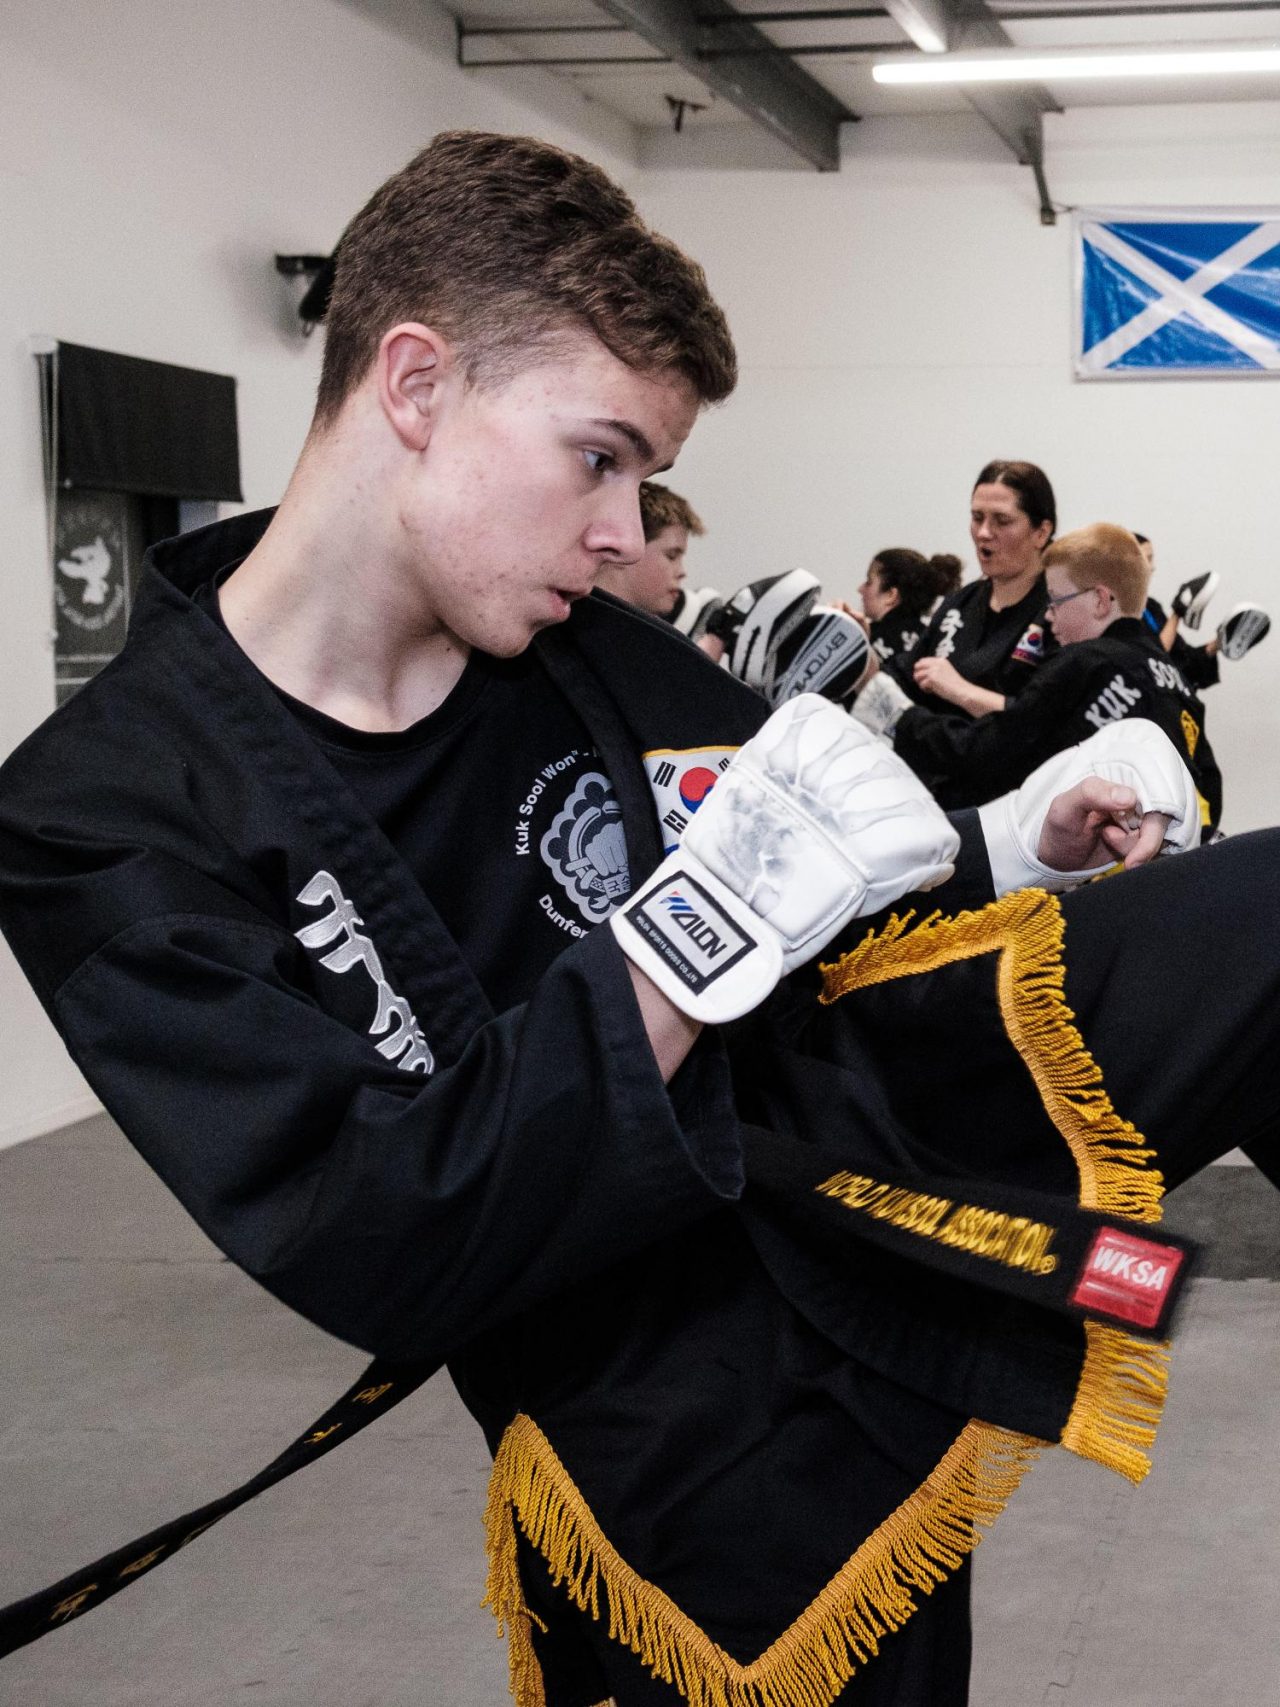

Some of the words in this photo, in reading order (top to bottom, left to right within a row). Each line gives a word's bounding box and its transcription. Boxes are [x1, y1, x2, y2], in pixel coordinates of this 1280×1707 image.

[519, 779, 547, 816] Sool
[515, 821, 530, 855] Kuk
[1093, 1245, 1167, 1291] WKSA
